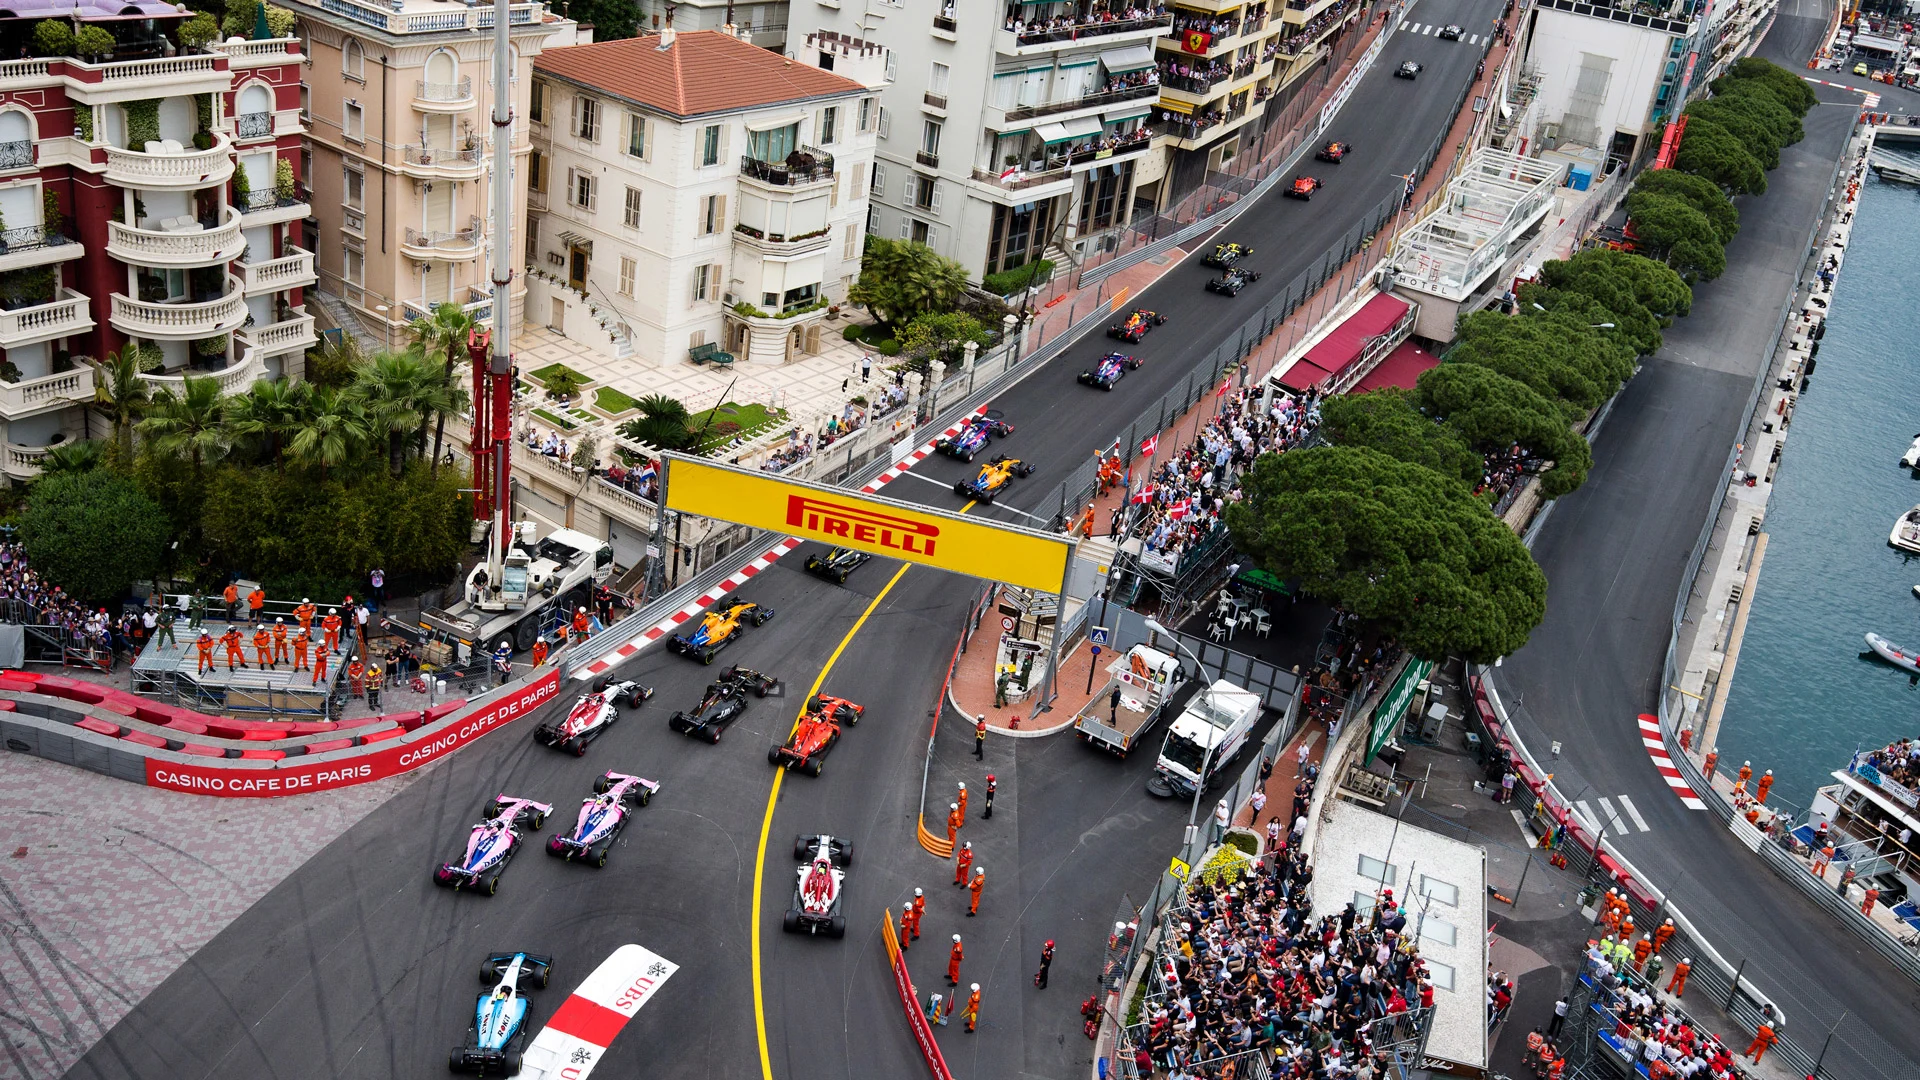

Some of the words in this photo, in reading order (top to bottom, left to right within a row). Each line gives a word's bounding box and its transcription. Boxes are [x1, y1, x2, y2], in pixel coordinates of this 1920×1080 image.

[1398, 275, 1447, 294] HOTEL
[786, 494, 940, 556] PIRELLI
[399, 733, 457, 767] CASINO
[459, 714, 496, 739] CAFE
[498, 702, 519, 720] DE
[521, 680, 558, 710] PARIS
[1371, 661, 1423, 752] Heineken
[155, 769, 224, 791] CASINO
[229, 778, 281, 791] CAFE
[285, 773, 313, 789] DE
[317, 764, 372, 784] PARIS
[615, 977, 656, 1010] UBS
